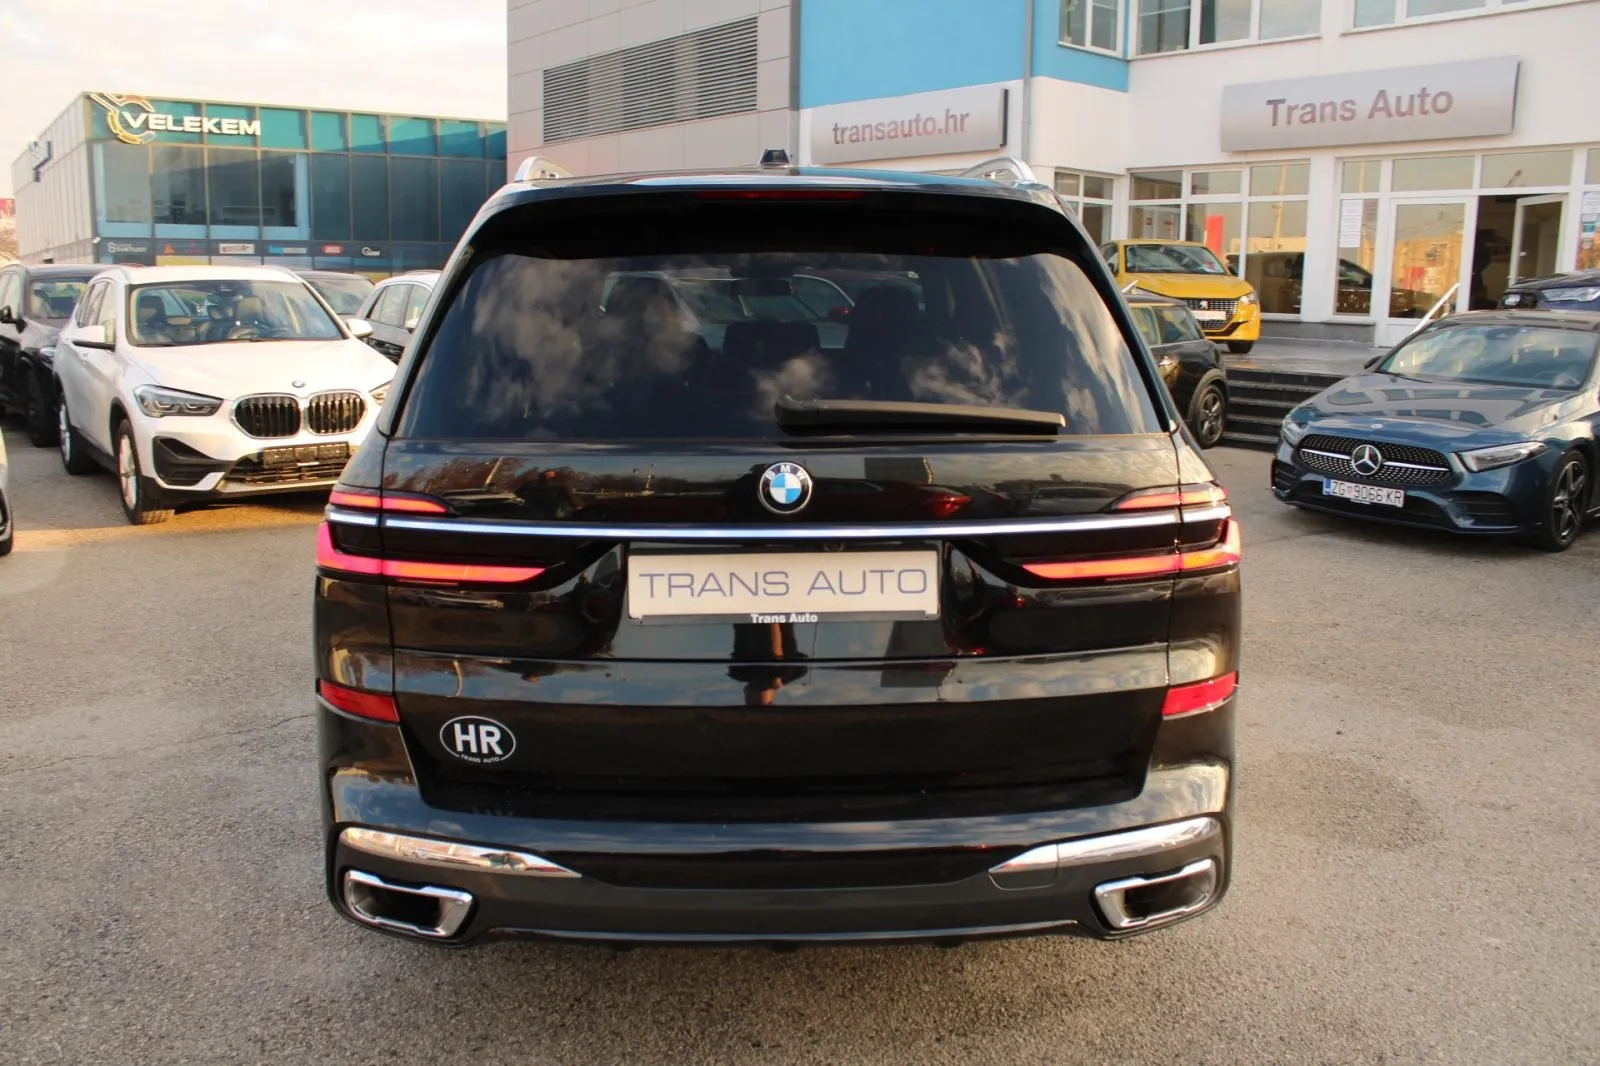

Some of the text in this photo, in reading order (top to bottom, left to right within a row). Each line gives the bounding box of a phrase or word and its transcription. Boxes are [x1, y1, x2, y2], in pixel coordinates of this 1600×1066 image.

[1266, 87, 1454, 127] Trans Auto
[122, 111, 261, 136] VELEKEM
[832, 109, 970, 144] transauto.hr
[639, 569, 927, 598] TRANS AUTO
[750, 612, 818, 624] Trans Auto
[454, 723, 503, 755] HR
